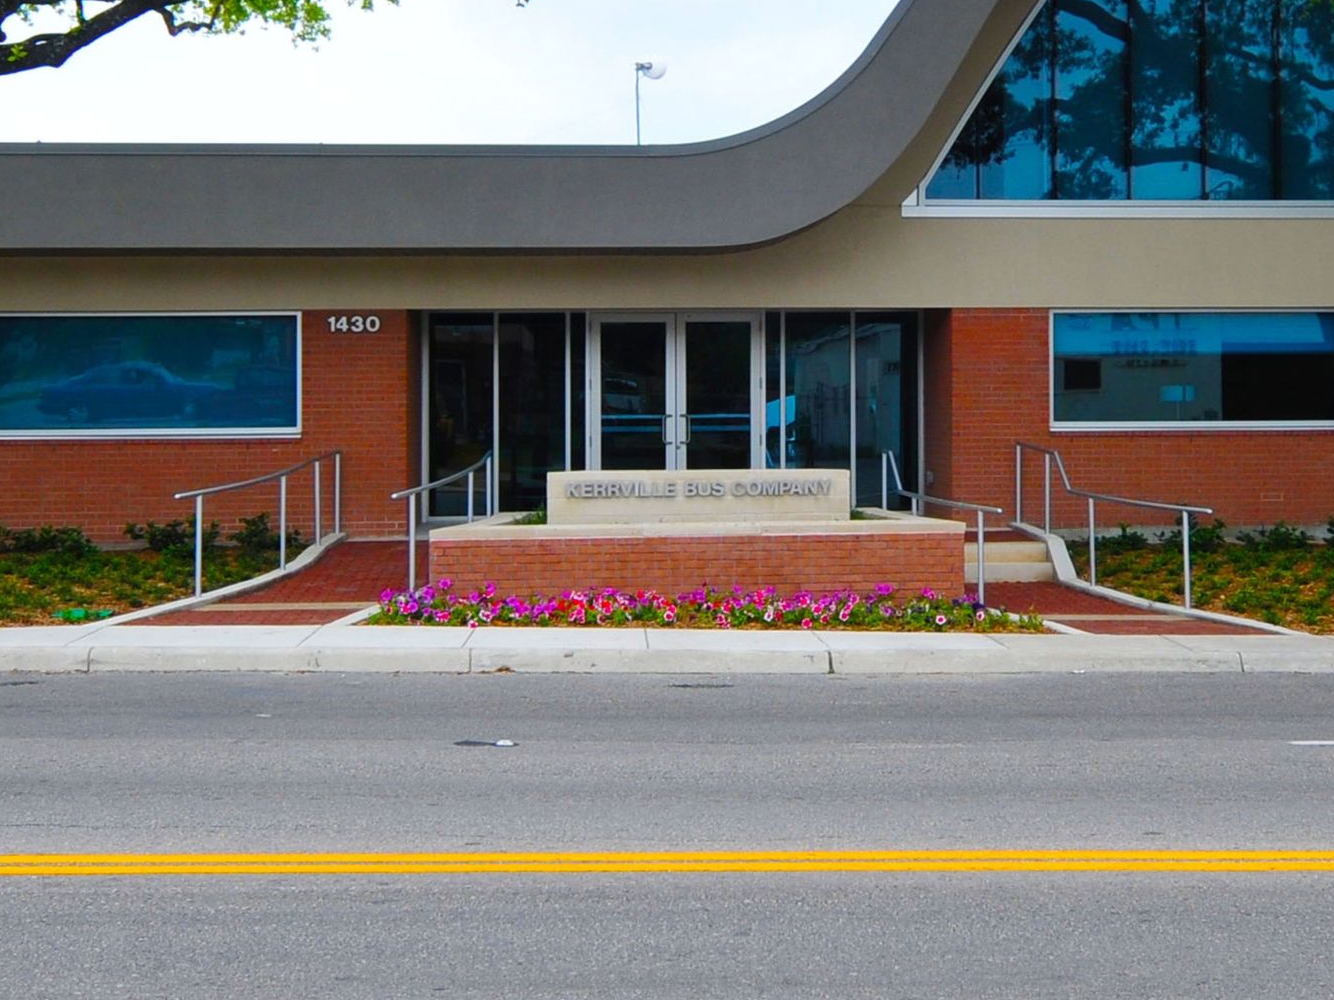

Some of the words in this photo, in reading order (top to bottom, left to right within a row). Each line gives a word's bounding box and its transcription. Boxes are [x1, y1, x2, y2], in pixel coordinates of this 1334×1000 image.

[327, 315, 380, 333] 1430
[566, 481, 676, 498] KERRVILLE
[685, 481, 725, 497] BUS
[732, 479, 831, 497] COMPANY
